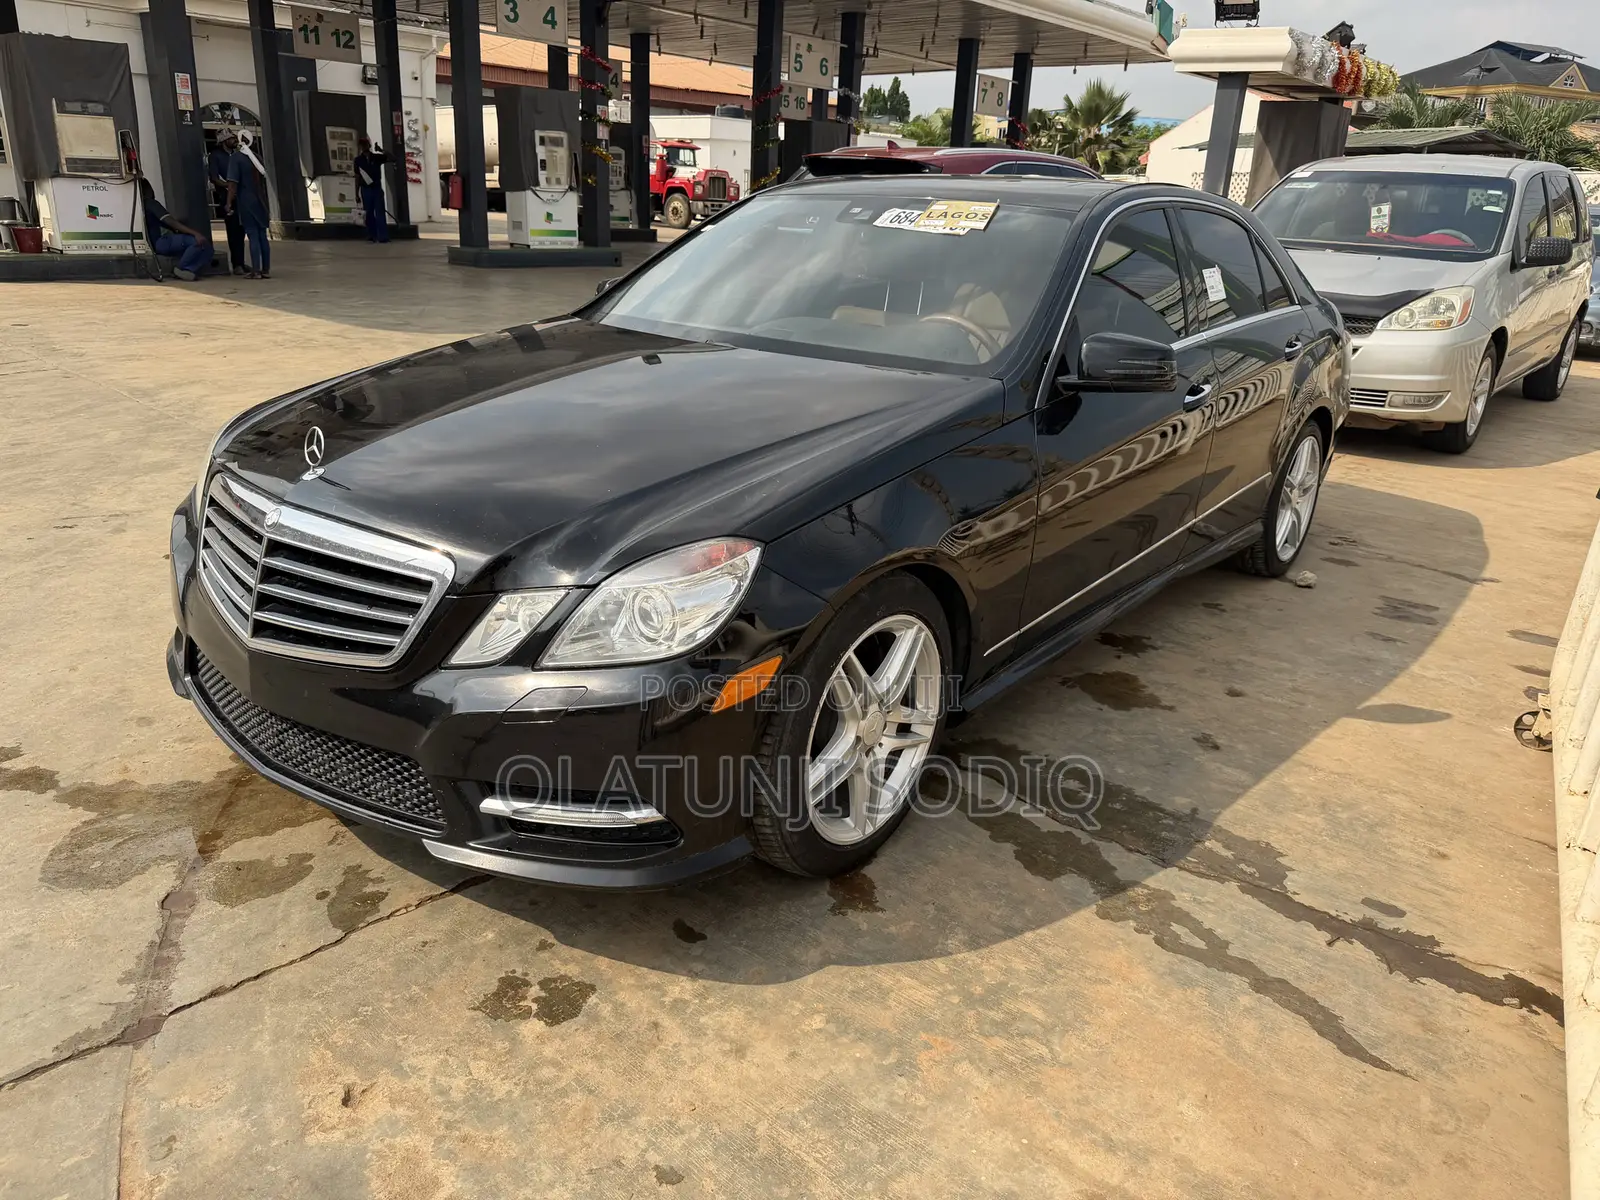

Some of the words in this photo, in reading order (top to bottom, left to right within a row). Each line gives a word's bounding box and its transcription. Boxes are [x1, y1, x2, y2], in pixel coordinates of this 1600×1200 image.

[504, 0, 519, 23] 3
[543, 6, 557, 29] 4
[298, 24, 320, 45] 11
[331, 29, 355, 49] 12
[794, 53, 803, 73] 5
[820, 58, 829, 76] 6
[794, 96, 805, 110] 16
[981, 88, 988, 103] 7
[997, 92, 1004, 107] 8
[926, 211, 991, 220] LAGOS
